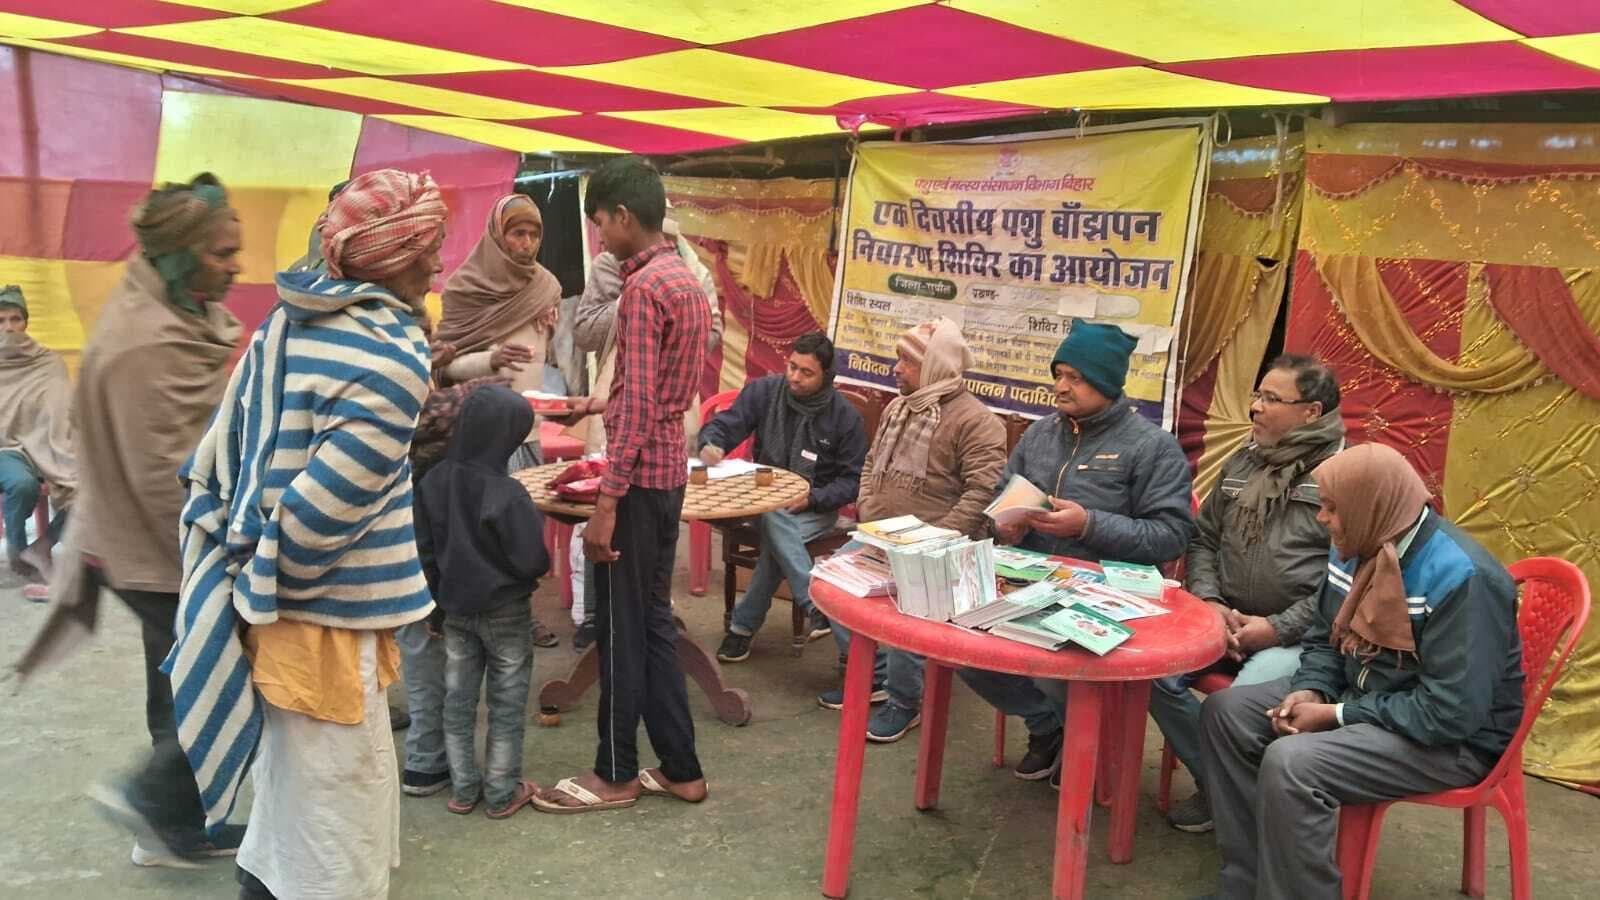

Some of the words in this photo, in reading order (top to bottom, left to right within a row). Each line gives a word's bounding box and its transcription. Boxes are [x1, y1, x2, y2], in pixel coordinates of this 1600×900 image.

[873, 200, 908, 228] एक
[910, 198, 997, 236] दिवसीय
[1001, 208, 1045, 249] पशु
[852, 228, 933, 272] निवारण
[938, 239, 1003, 278] शिविर
[1008, 252, 1046, 282] का
[1050, 247, 1175, 290] आयोजन
[1028, 316, 1058, 334] शिविर
[847, 353, 891, 377] निवेदक
[963, 378, 1007, 399] पालन
